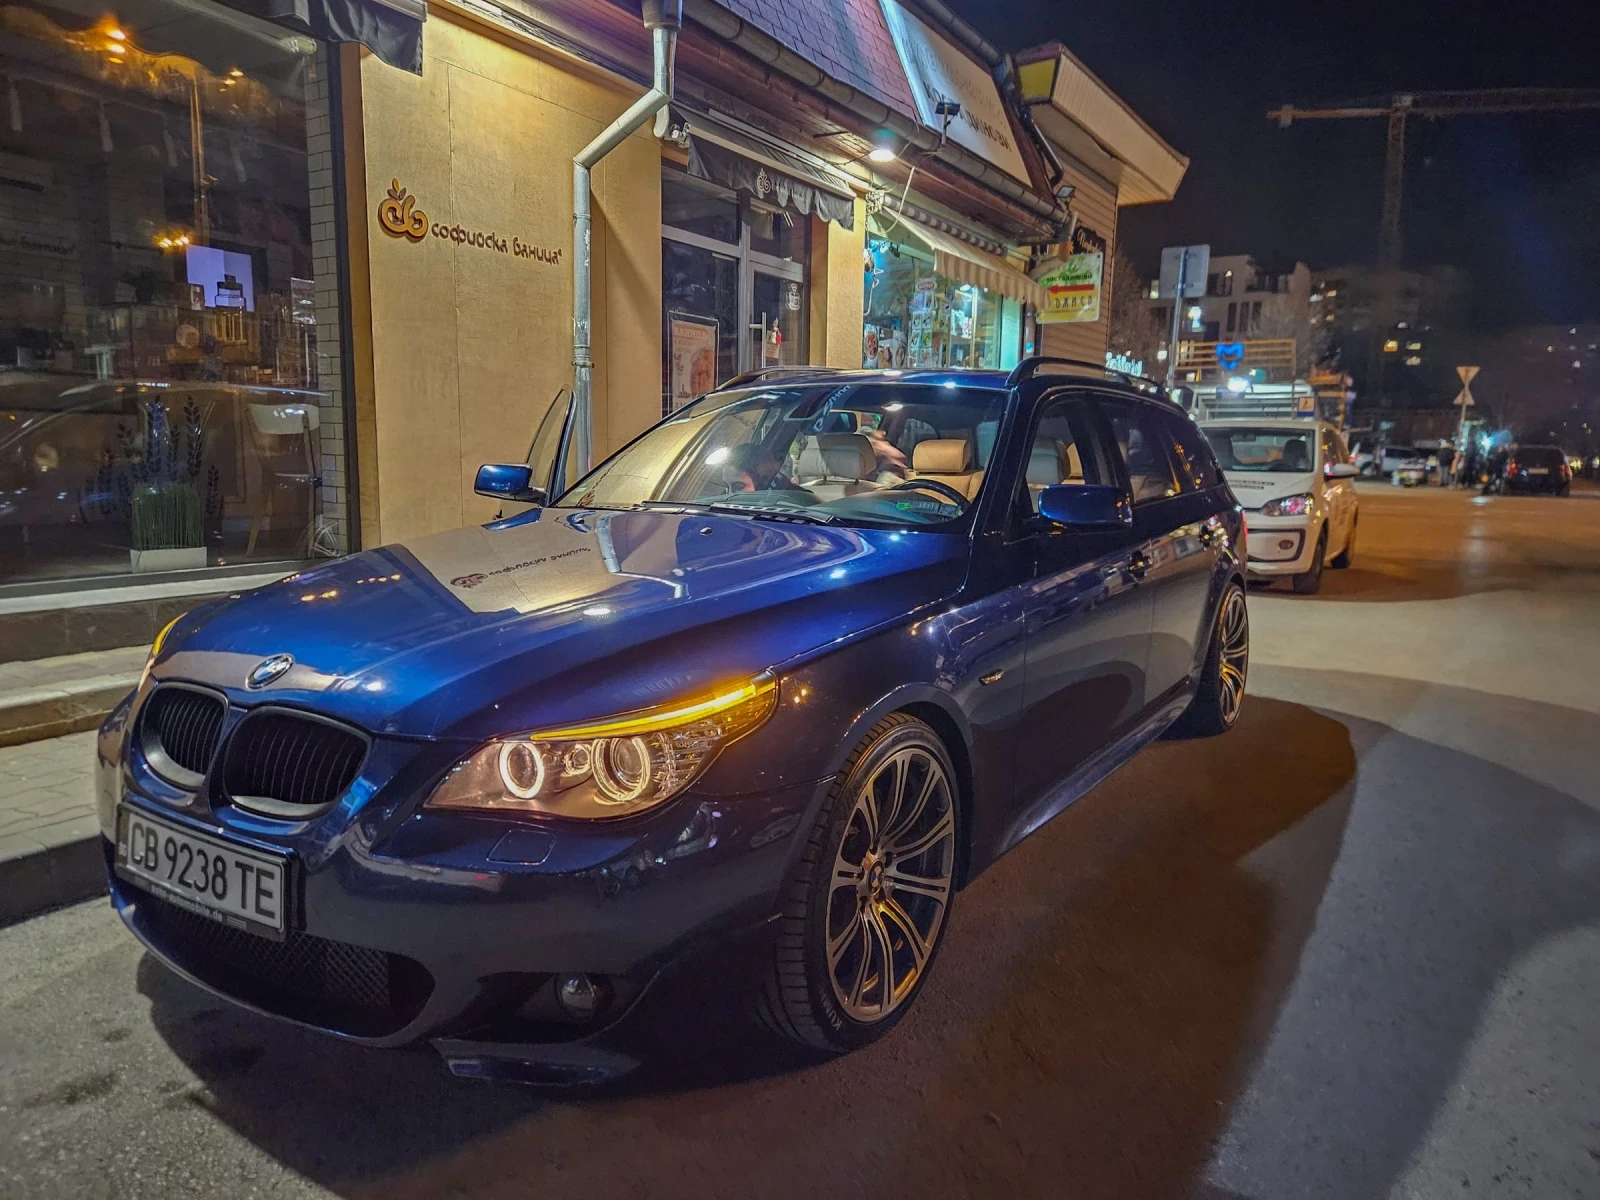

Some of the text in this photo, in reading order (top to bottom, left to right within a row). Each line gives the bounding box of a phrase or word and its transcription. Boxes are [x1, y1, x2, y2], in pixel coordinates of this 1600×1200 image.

[431, 222, 508, 254] софийска
[131, 822, 276, 920] CB 9238 TE
